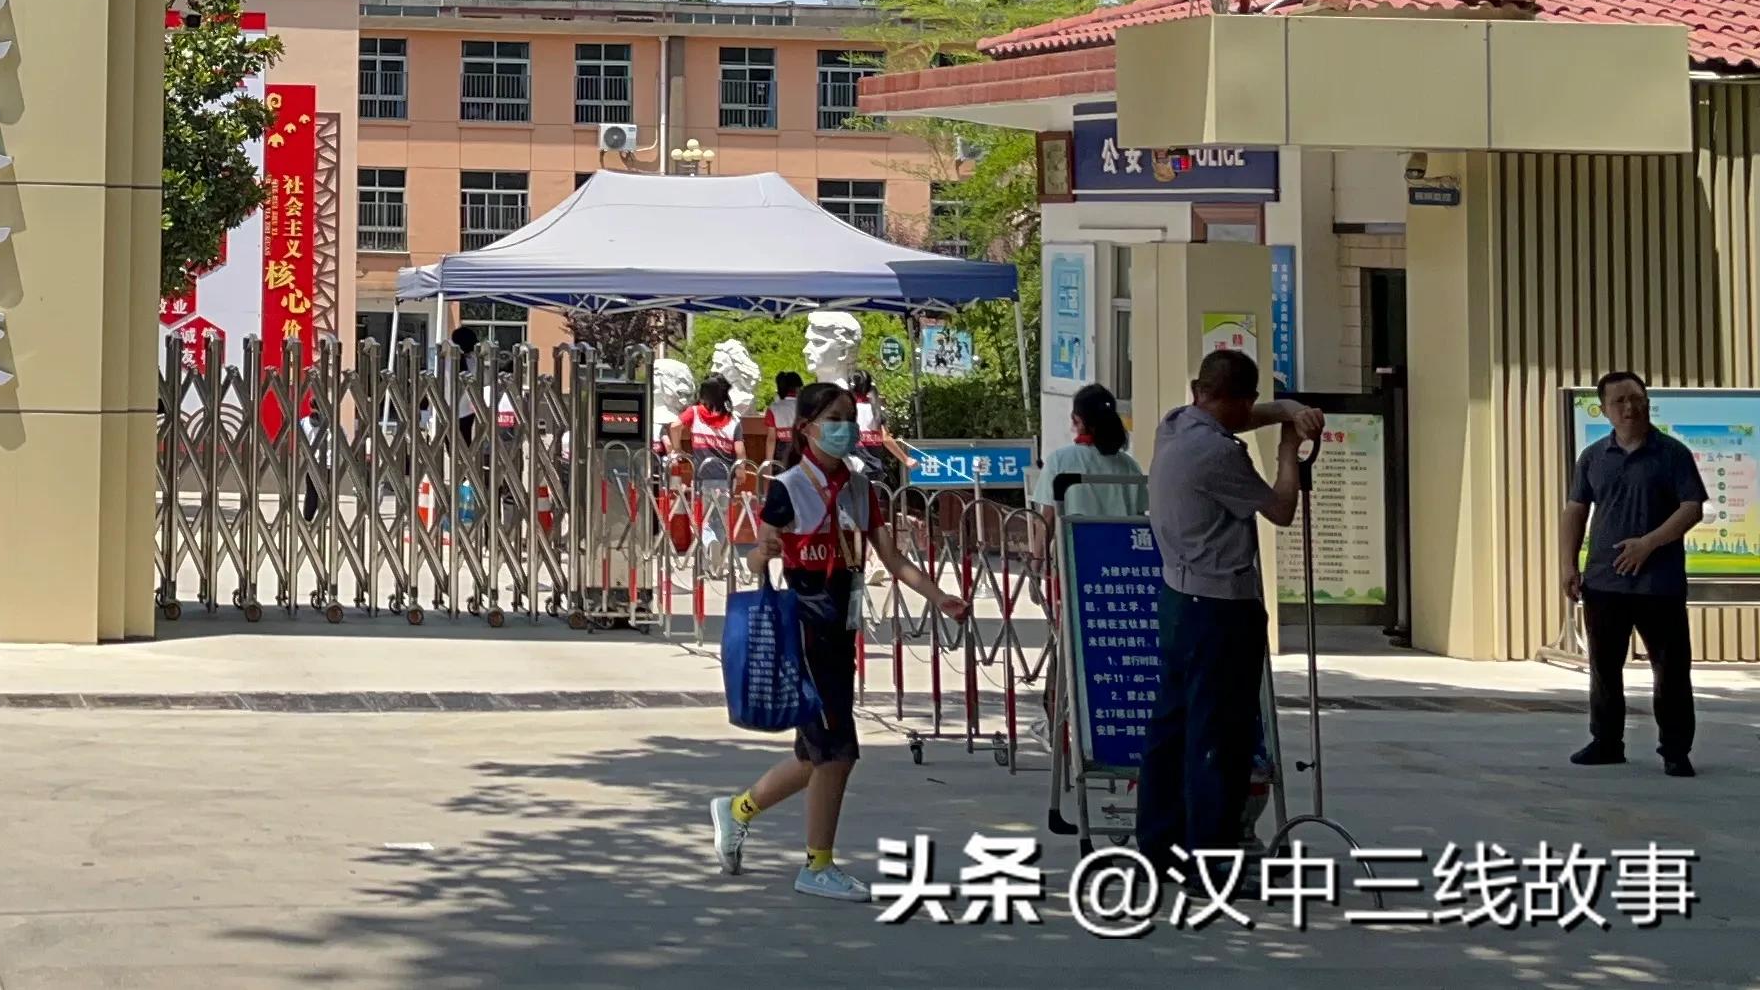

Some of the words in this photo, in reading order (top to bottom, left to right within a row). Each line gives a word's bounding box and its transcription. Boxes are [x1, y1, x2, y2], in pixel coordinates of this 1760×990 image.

[1188, 148, 1246, 167] OLICE
[264, 175, 311, 360] 社会主义核心价
[920, 455, 1018, 477] 进门登记
